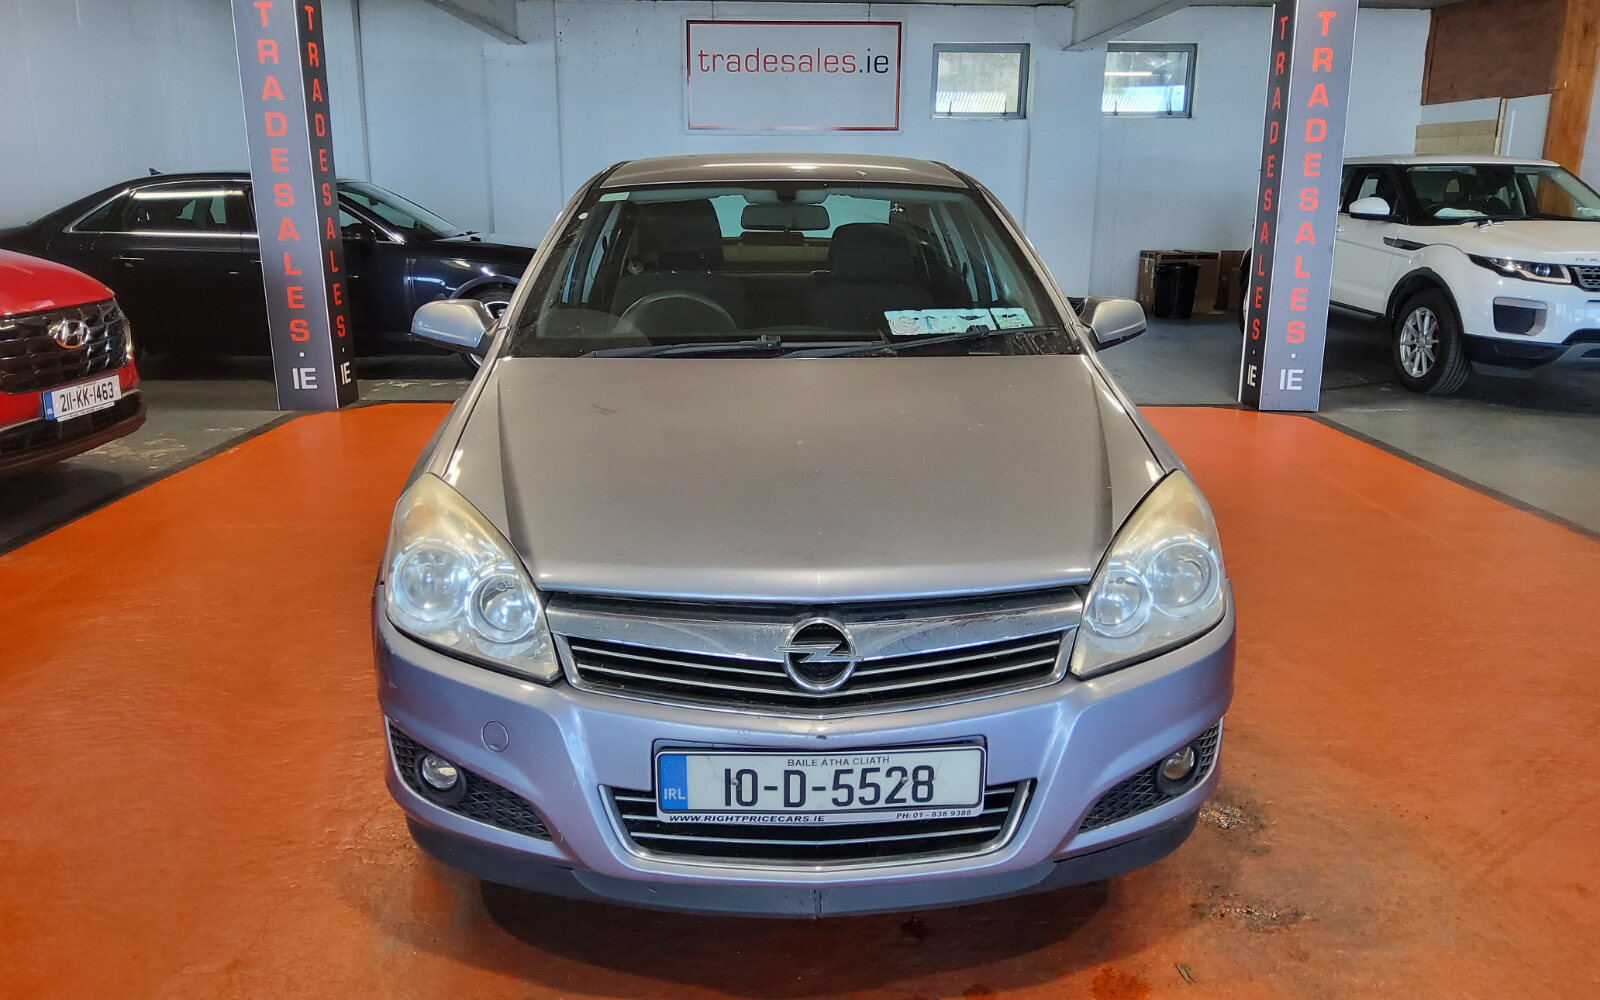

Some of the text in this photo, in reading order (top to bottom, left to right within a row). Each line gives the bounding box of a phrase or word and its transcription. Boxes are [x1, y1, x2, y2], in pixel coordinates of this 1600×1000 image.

[697, 47, 889, 74] tradesales.ie
[59, 381, 115, 413] 211-KK-1463
[787, 755, 890, 767] BAILE ÁTHA CLIATH
[724, 764, 935, 808] 10-D-5528
[663, 787, 687, 801] IRL
[669, 815, 826, 823] WWW.RIGHTPRICECARS.IE
[931, 810, 948, 818] 838
[950, 809, 972, 817] 9388
